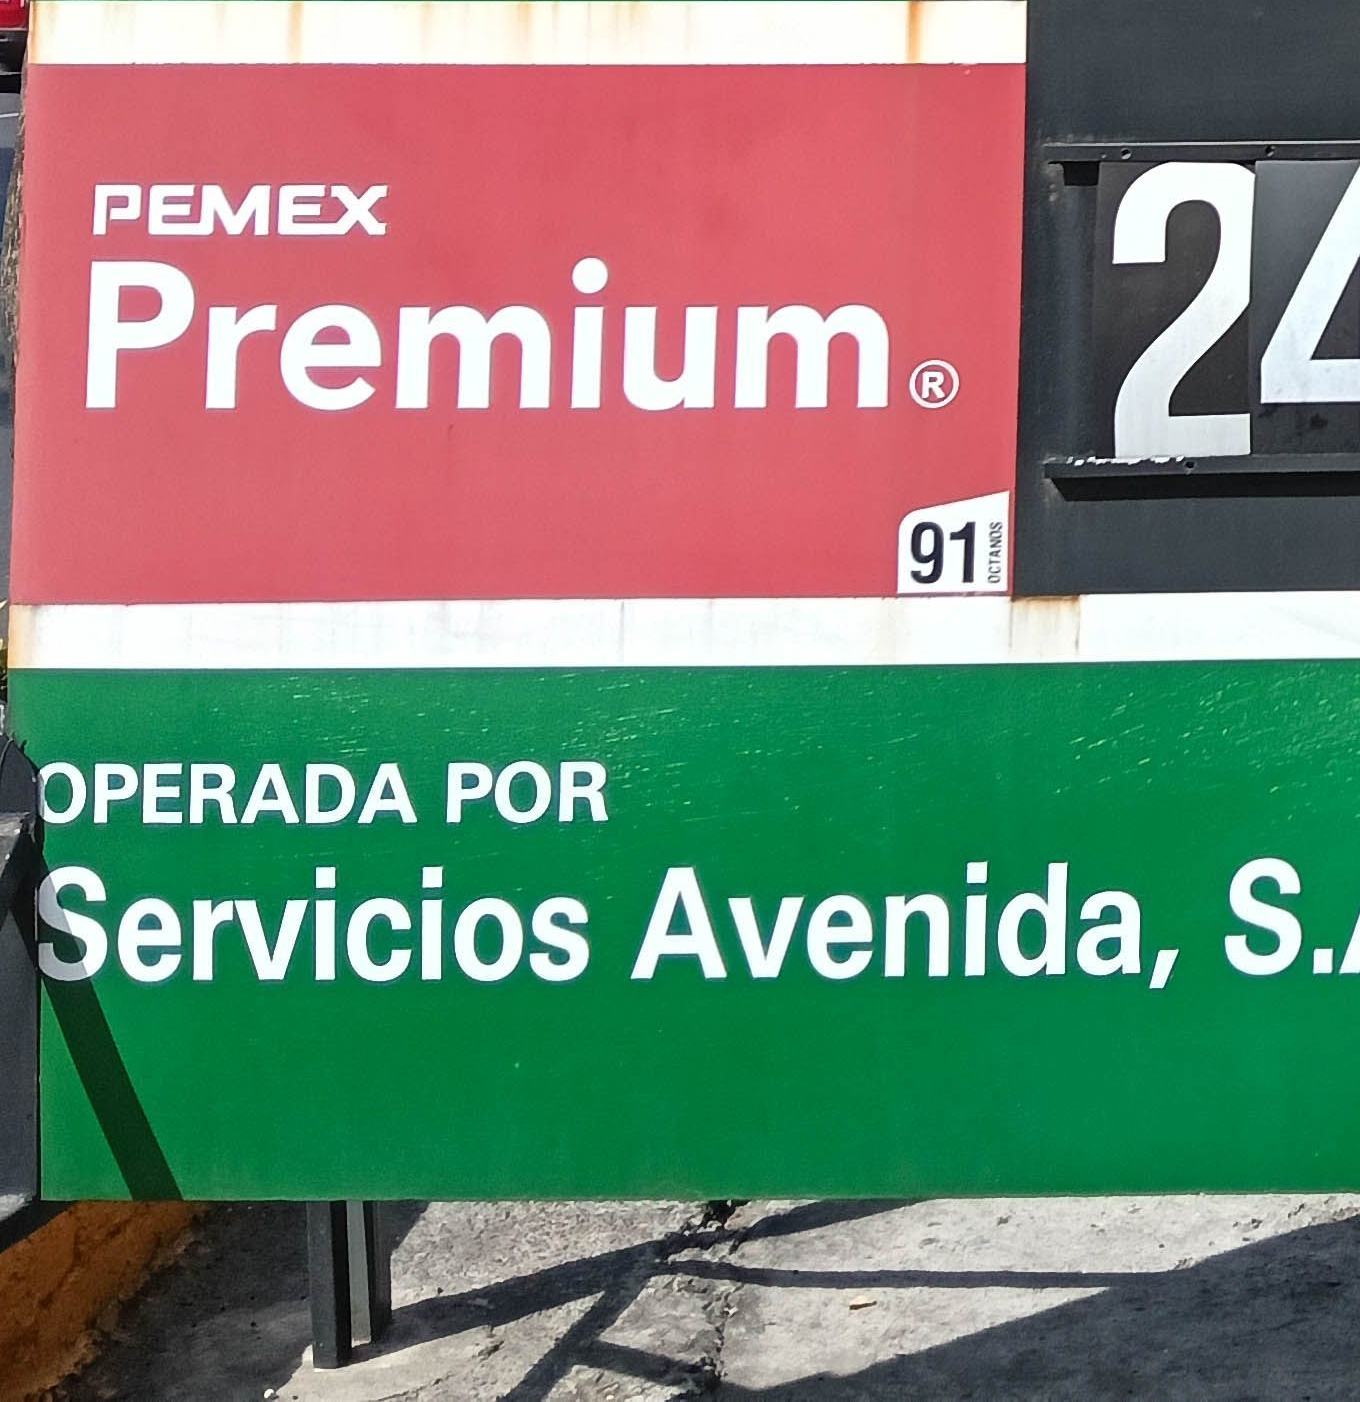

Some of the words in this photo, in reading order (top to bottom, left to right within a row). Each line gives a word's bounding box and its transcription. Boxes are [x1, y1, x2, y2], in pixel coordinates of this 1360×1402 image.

[93, 184, 388, 236] PEMEX
[85, 257, 889, 411] Premium
[910, 520, 976, 584] 91
[987, 520, 1003, 584] OCTANOS
[39, 762, 418, 825] OPERADA
[446, 761, 609, 824] POR
[38, 864, 590, 983] Servicios
[631, 861, 1179, 989] Avenida,
